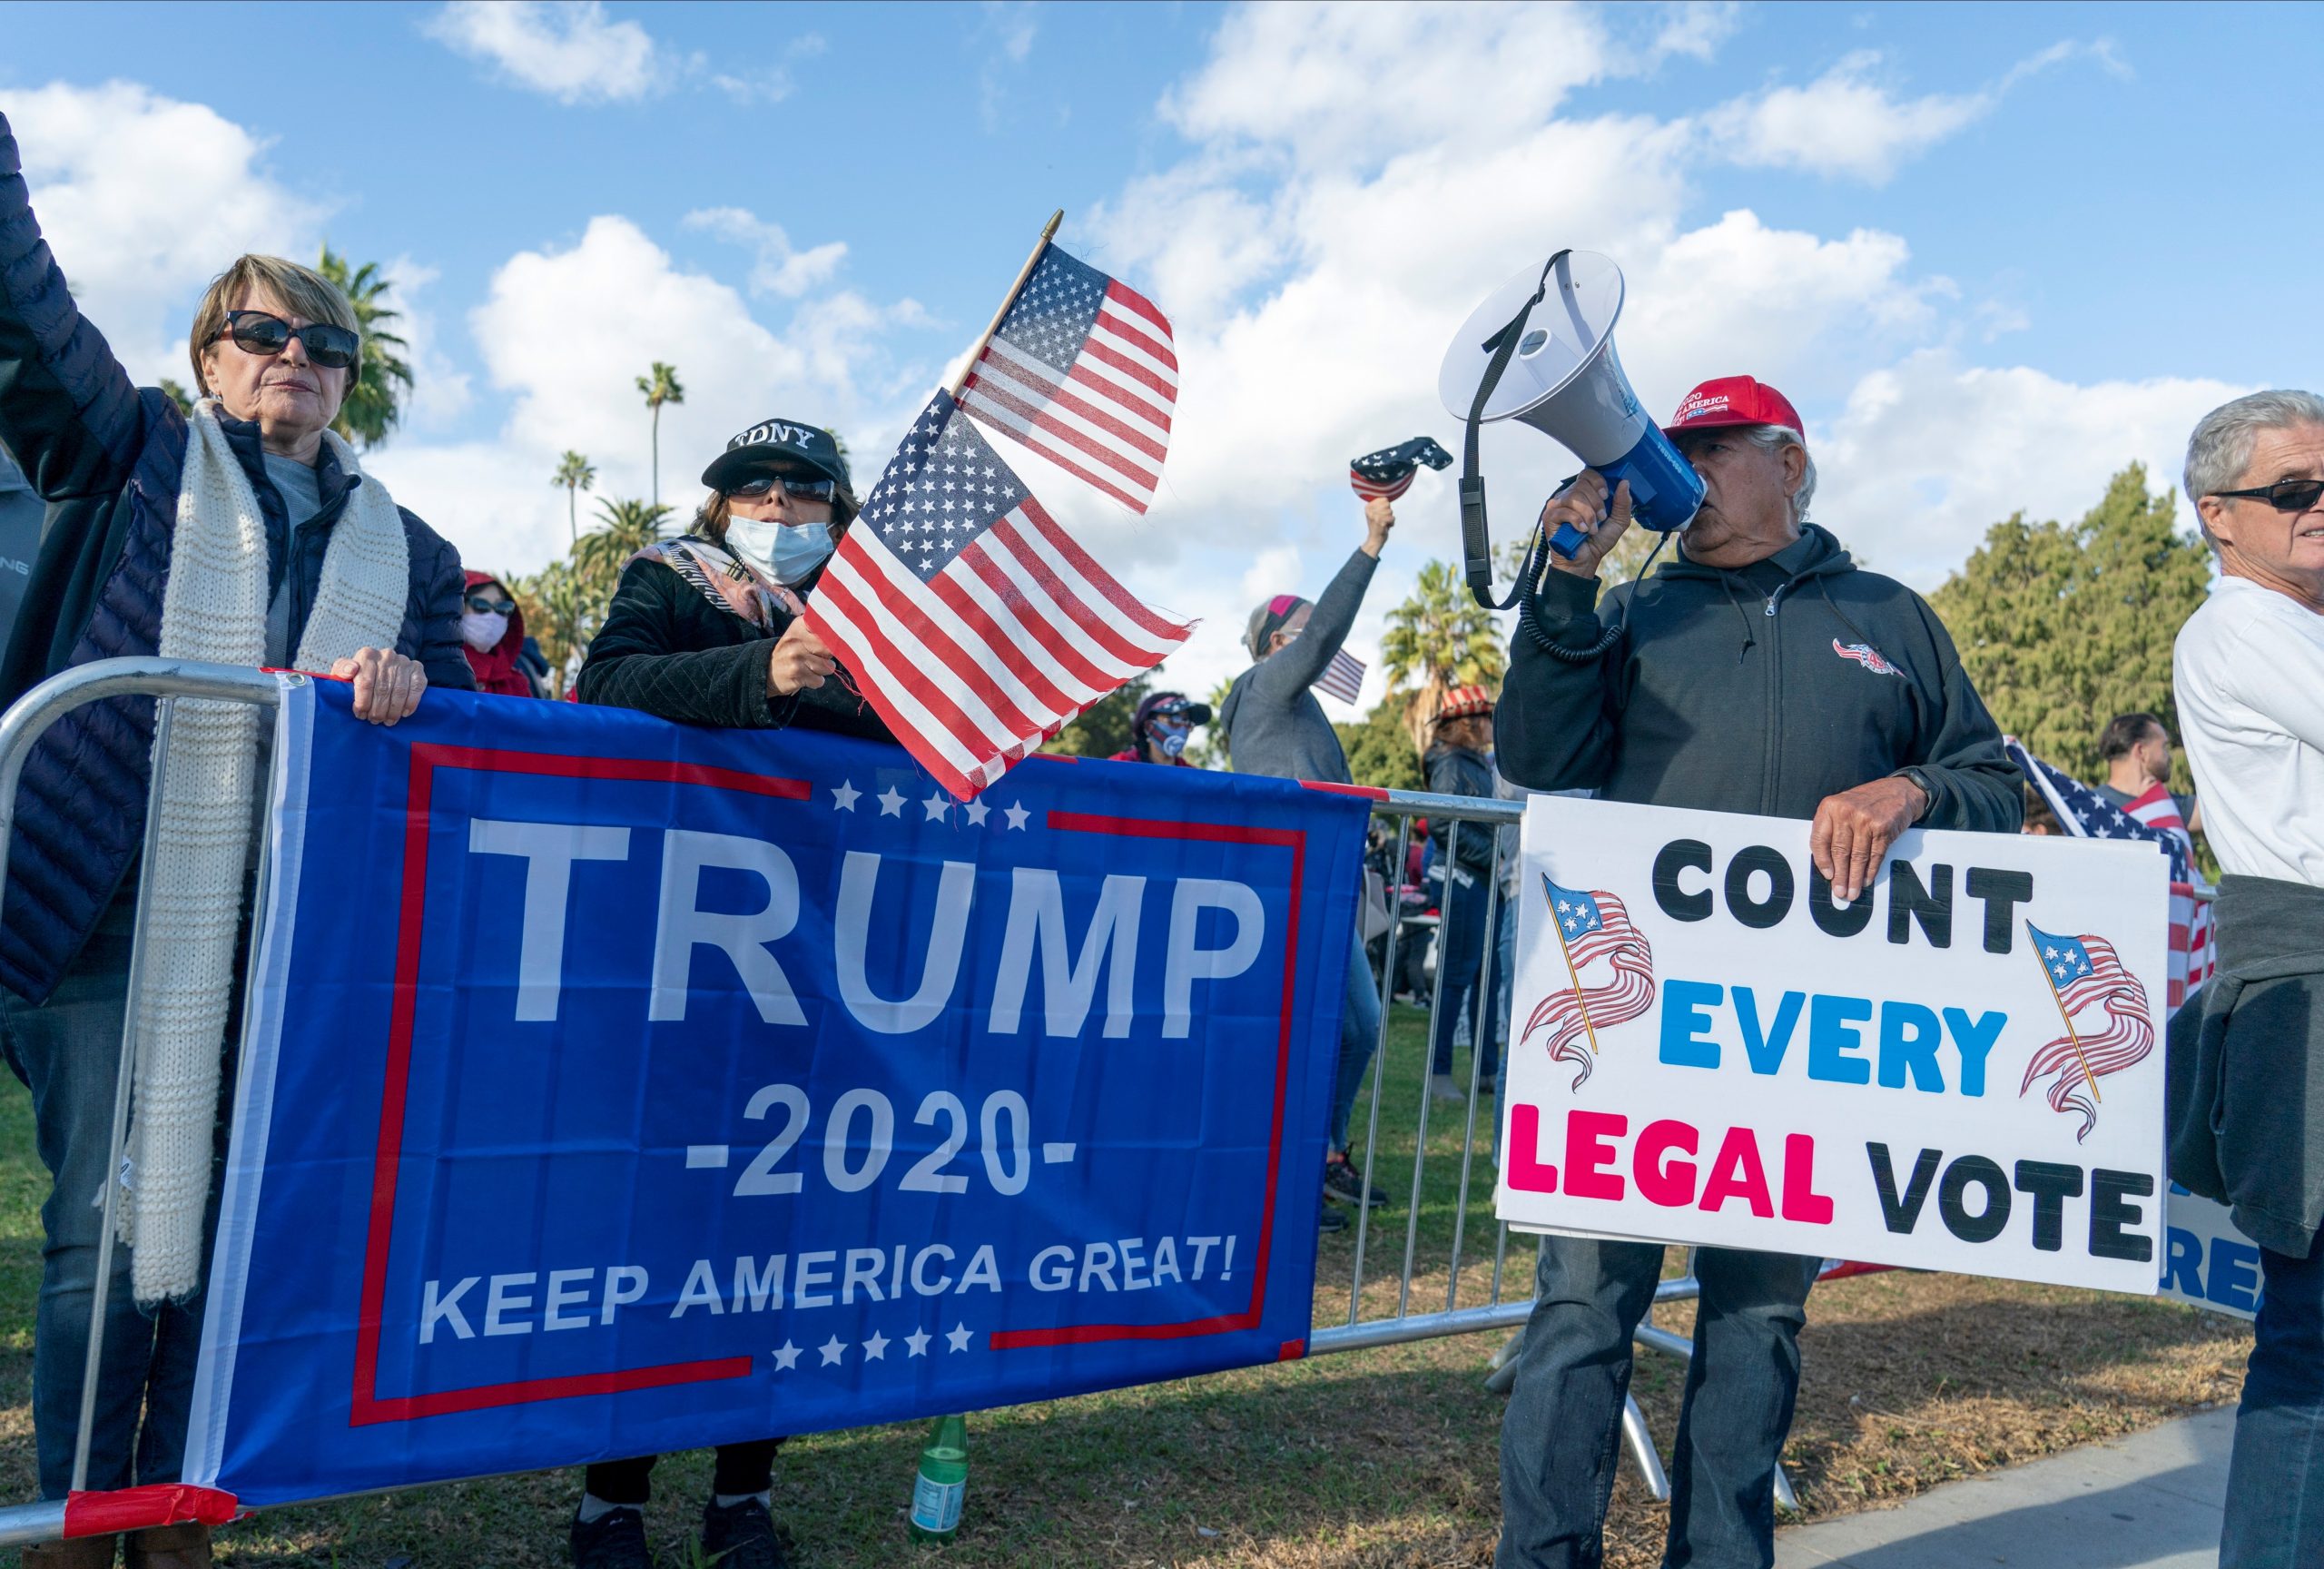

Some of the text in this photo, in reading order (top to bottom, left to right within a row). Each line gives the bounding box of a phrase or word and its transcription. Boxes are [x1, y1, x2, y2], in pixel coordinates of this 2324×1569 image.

[1682, 395, 1728, 414] AMERICA
[468, 817, 1265, 1039] TRUMP
[1652, 838, 2033, 954] COUNT
[1659, 979, 2007, 1097] EVERY
[1507, 1103, 2153, 1263] LEGAL VOTE
[419, 1234, 1237, 1345] KEEP AMERICA GREAT!
[2160, 1225, 2265, 1313] RE
